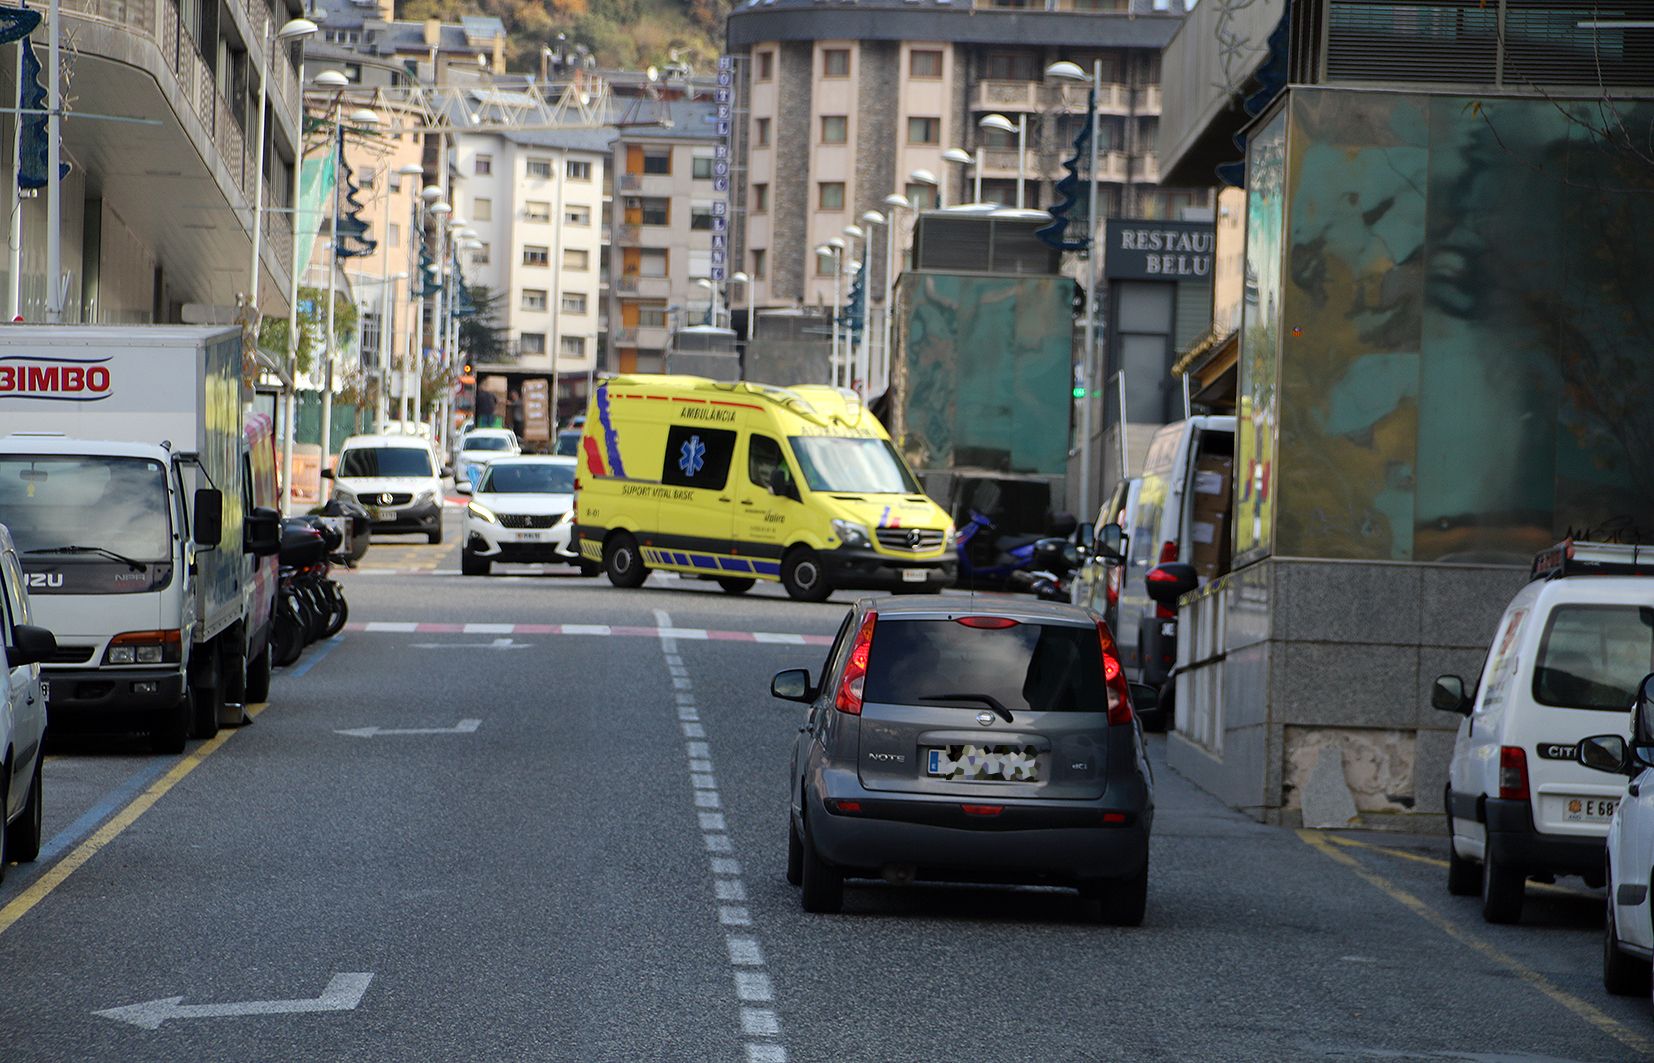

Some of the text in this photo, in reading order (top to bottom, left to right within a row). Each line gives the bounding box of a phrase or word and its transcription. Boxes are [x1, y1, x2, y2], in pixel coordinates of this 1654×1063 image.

[711, 56, 731, 280] HOTEL ROC BLANC
[1145, 253, 1210, 275] BELU
[0, 366, 110, 392] BIMBO
[622, 485, 651, 497] SUPORT
[652, 487, 672, 499] VITAL
[868, 752, 905, 762] NOTE
[1586, 800, 1594, 816] E
